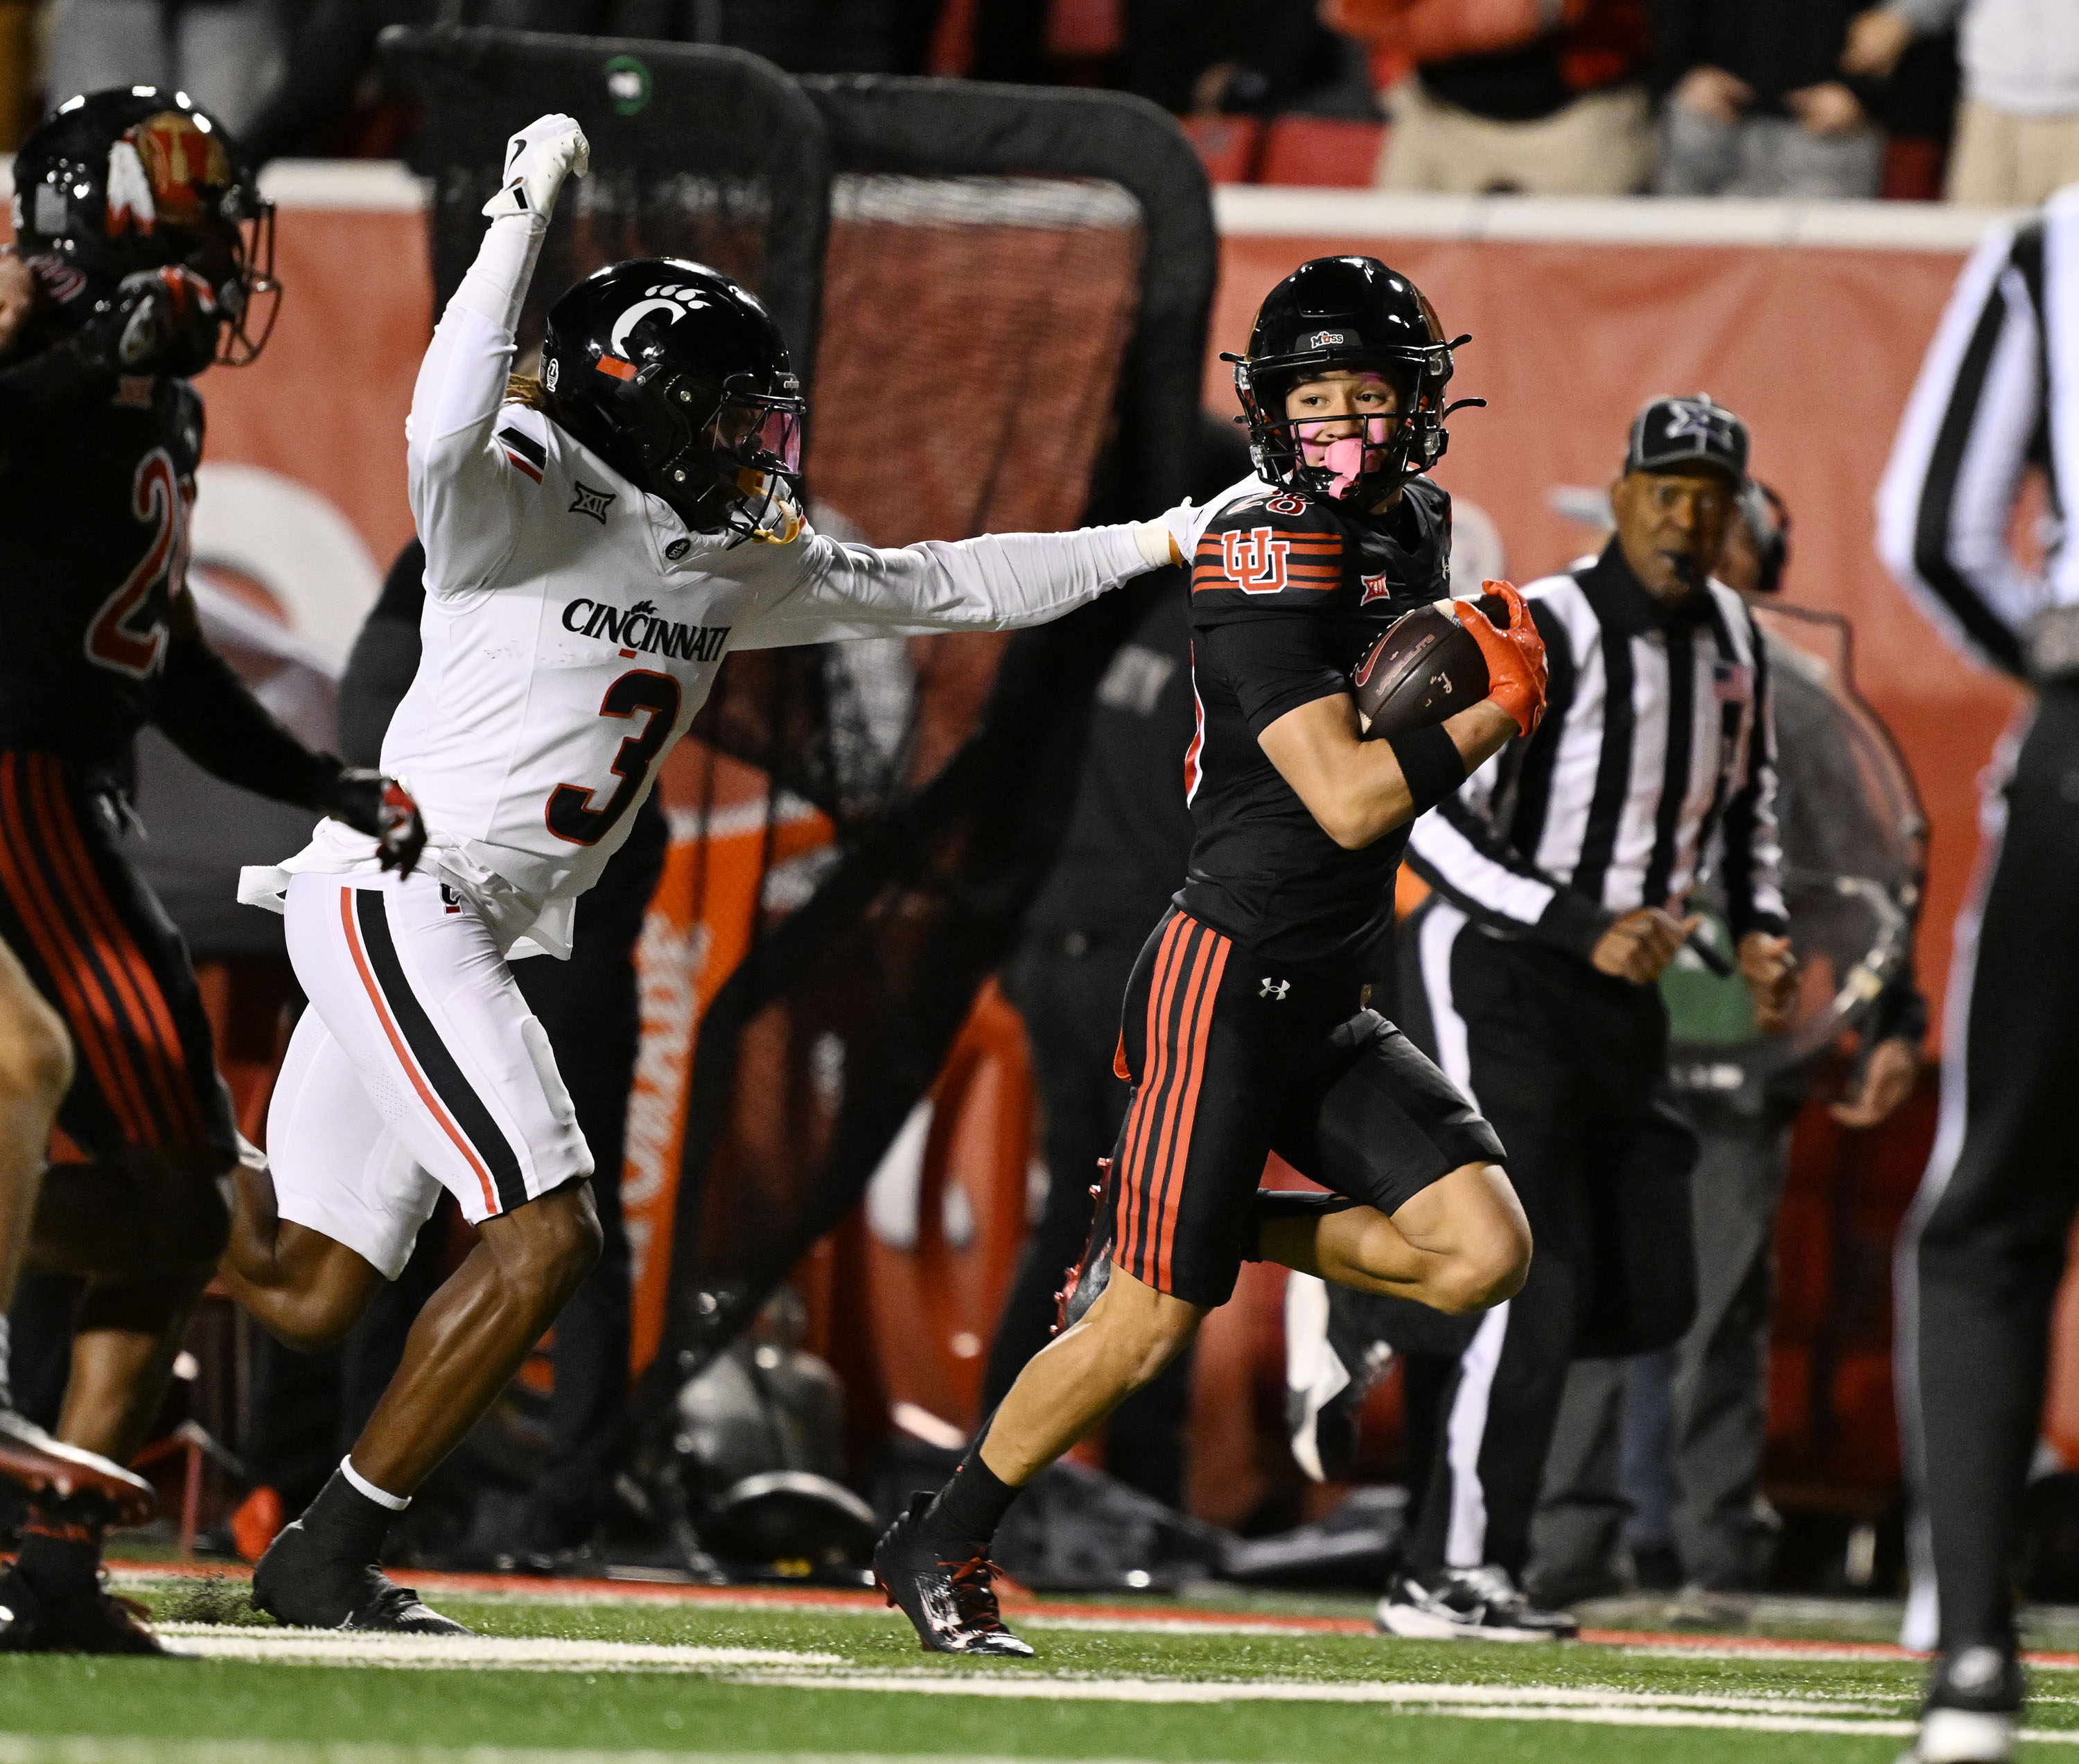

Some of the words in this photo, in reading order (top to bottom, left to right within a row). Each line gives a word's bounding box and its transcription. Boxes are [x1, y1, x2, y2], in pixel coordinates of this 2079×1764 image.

[1227, 490, 1315, 516] 28
[562, 599, 731, 661] CINCINNATI
[545, 669, 681, 846] 3
